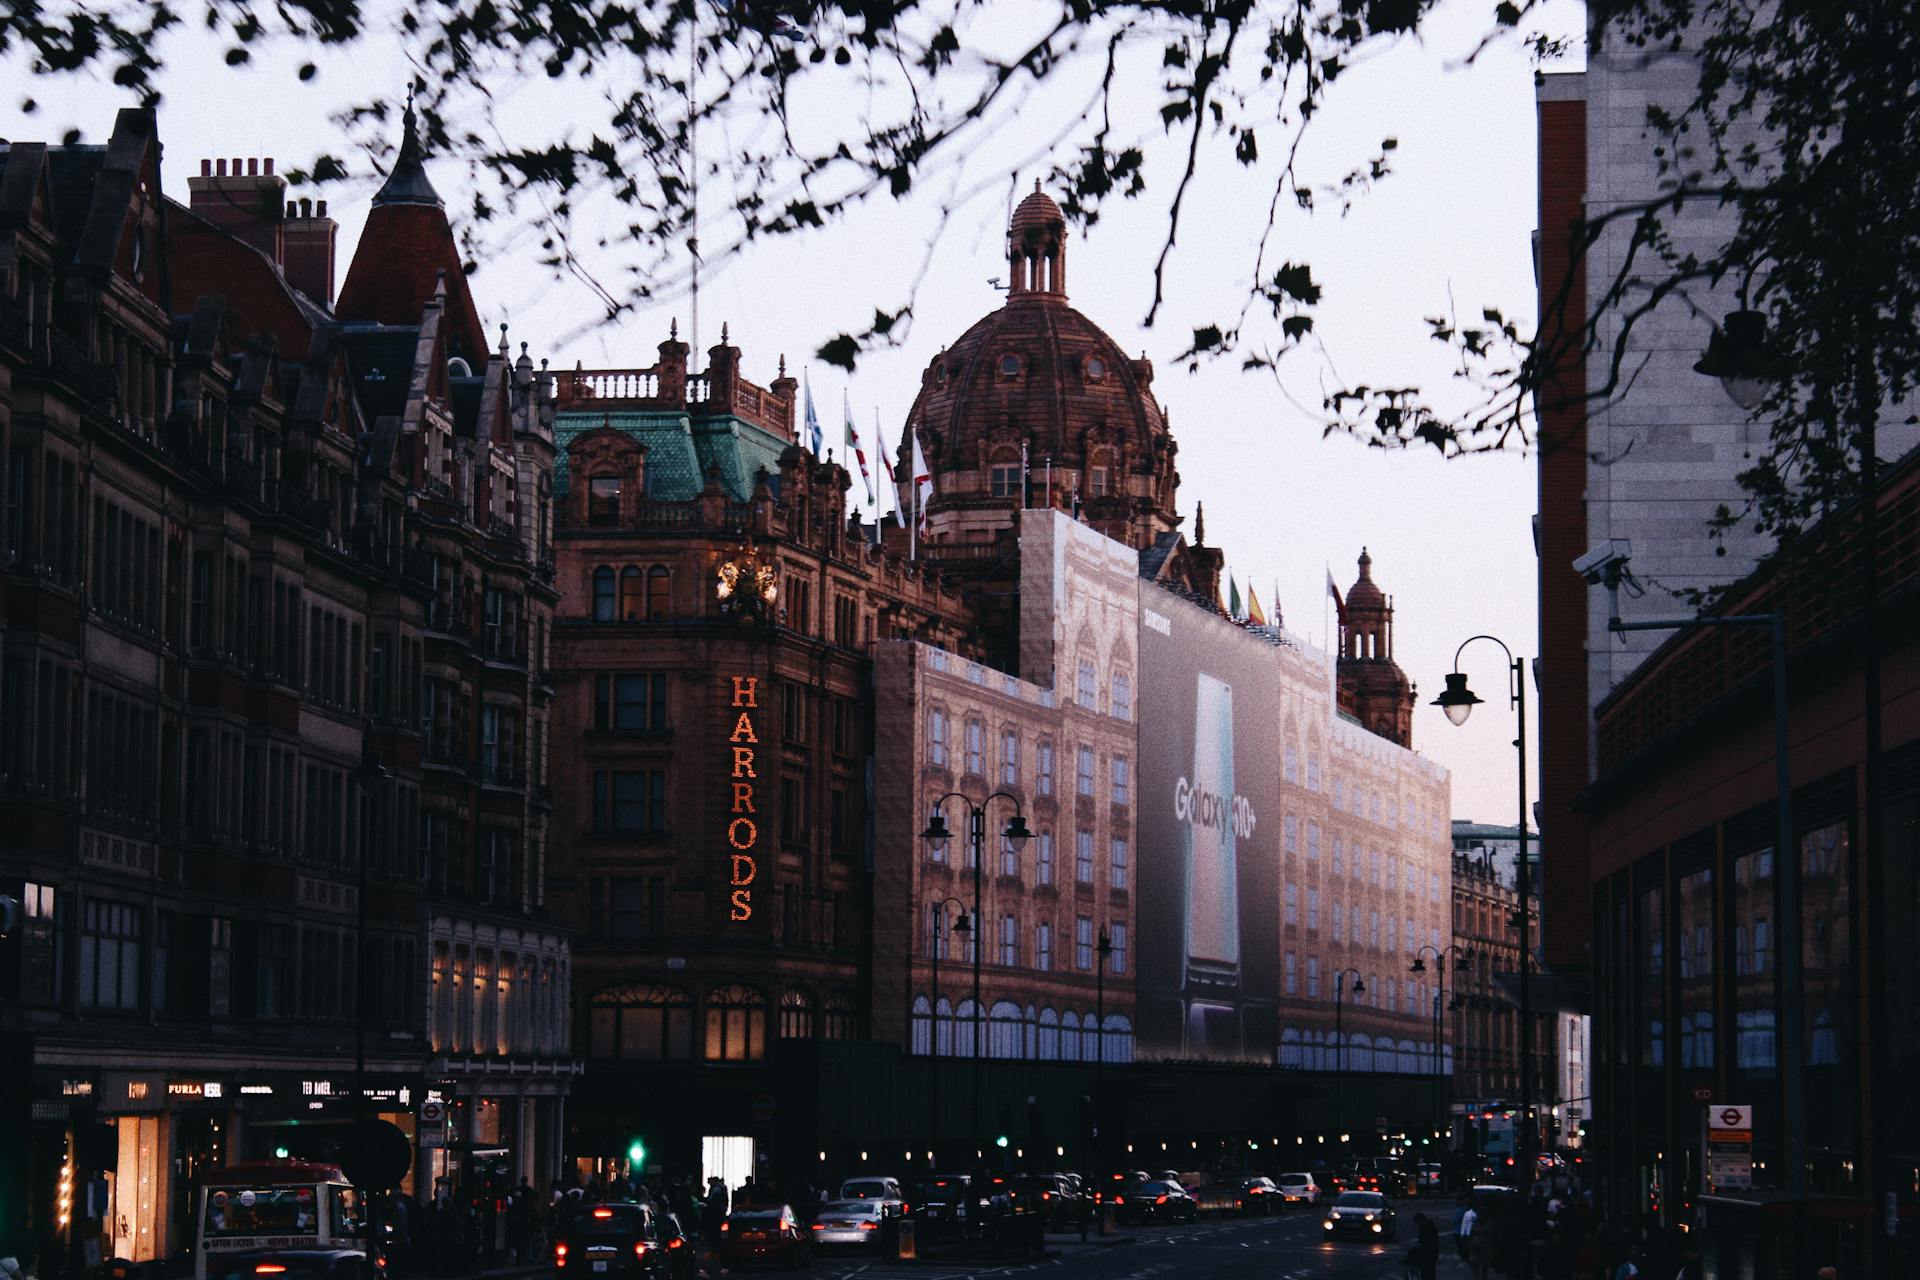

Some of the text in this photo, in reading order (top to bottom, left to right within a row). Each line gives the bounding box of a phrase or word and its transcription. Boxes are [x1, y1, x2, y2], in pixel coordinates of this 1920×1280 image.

[1144, 608, 1171, 637] SAMSUNG
[728, 675, 759, 922] HARRODS
[1175, 777, 1228, 845] Galaxy
[168, 1085, 202, 1094] FURLA
